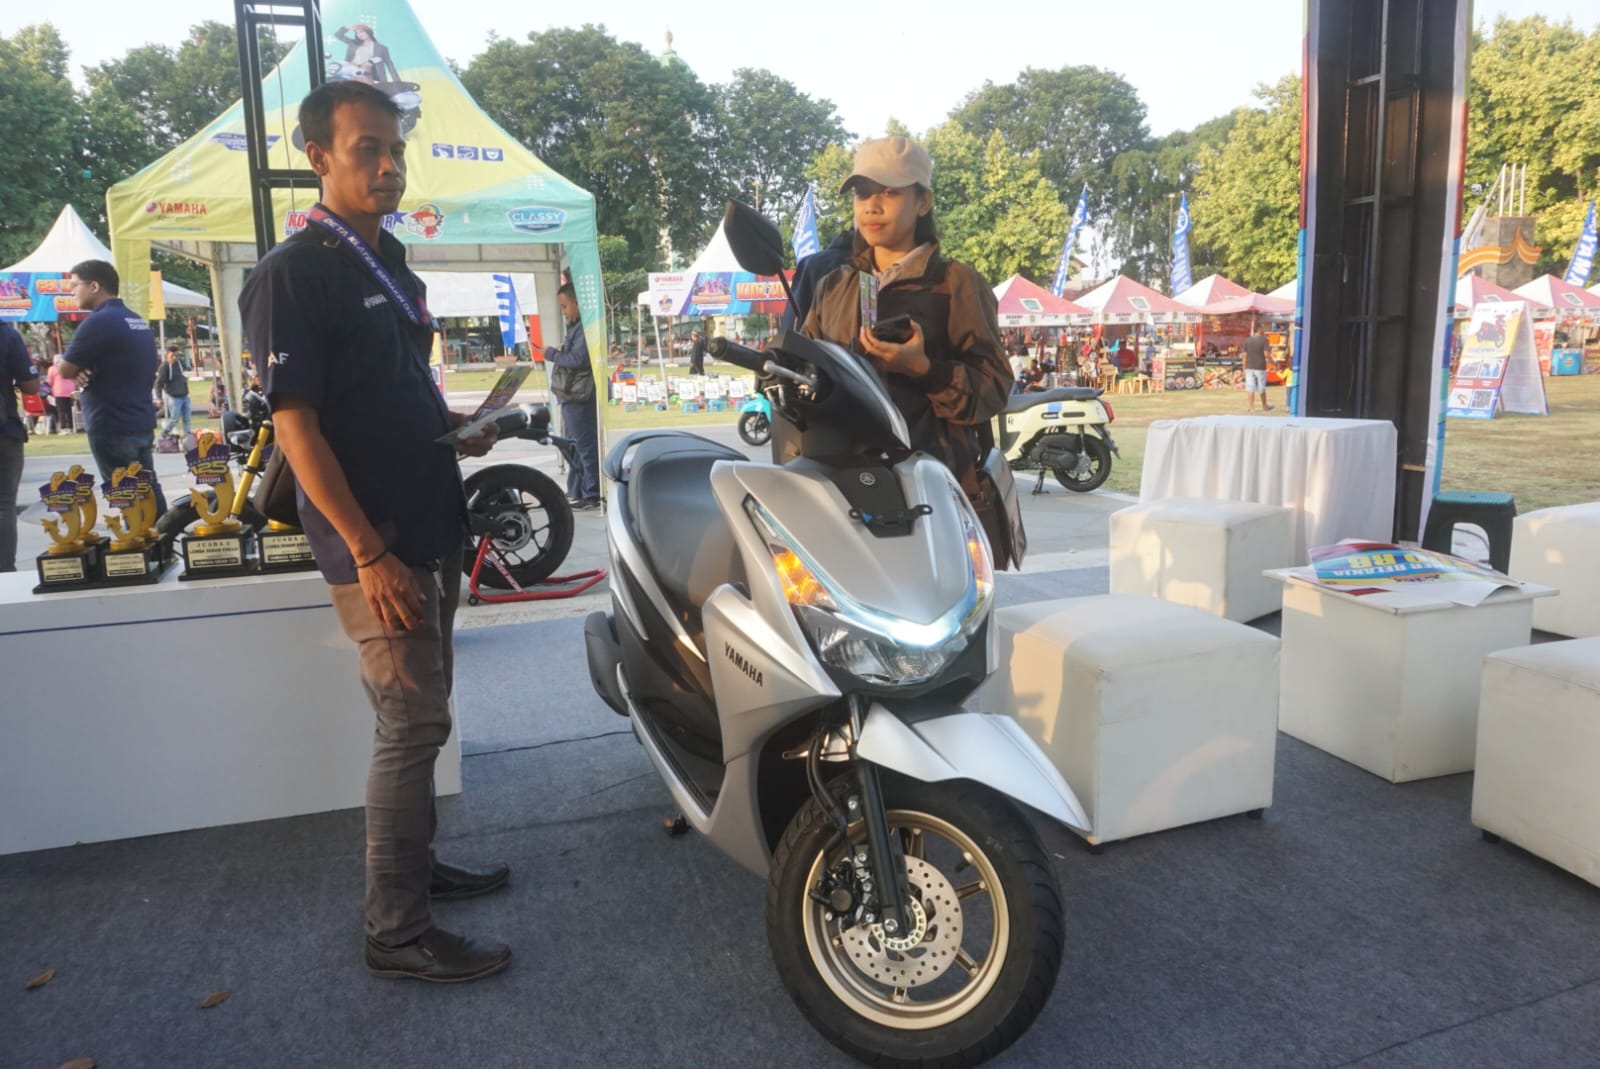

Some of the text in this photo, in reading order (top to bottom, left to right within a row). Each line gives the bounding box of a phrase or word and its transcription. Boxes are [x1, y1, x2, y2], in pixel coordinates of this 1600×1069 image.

[159, 202, 208, 215] YAMAHA
[511, 212, 562, 222] CLASSY
[1566, 233, 1598, 288] YAMA
[267, 351, 289, 368] AF
[191, 460, 228, 475] 125
[1348, 553, 1398, 569] RB
[725, 640, 763, 688] YAMAHA
